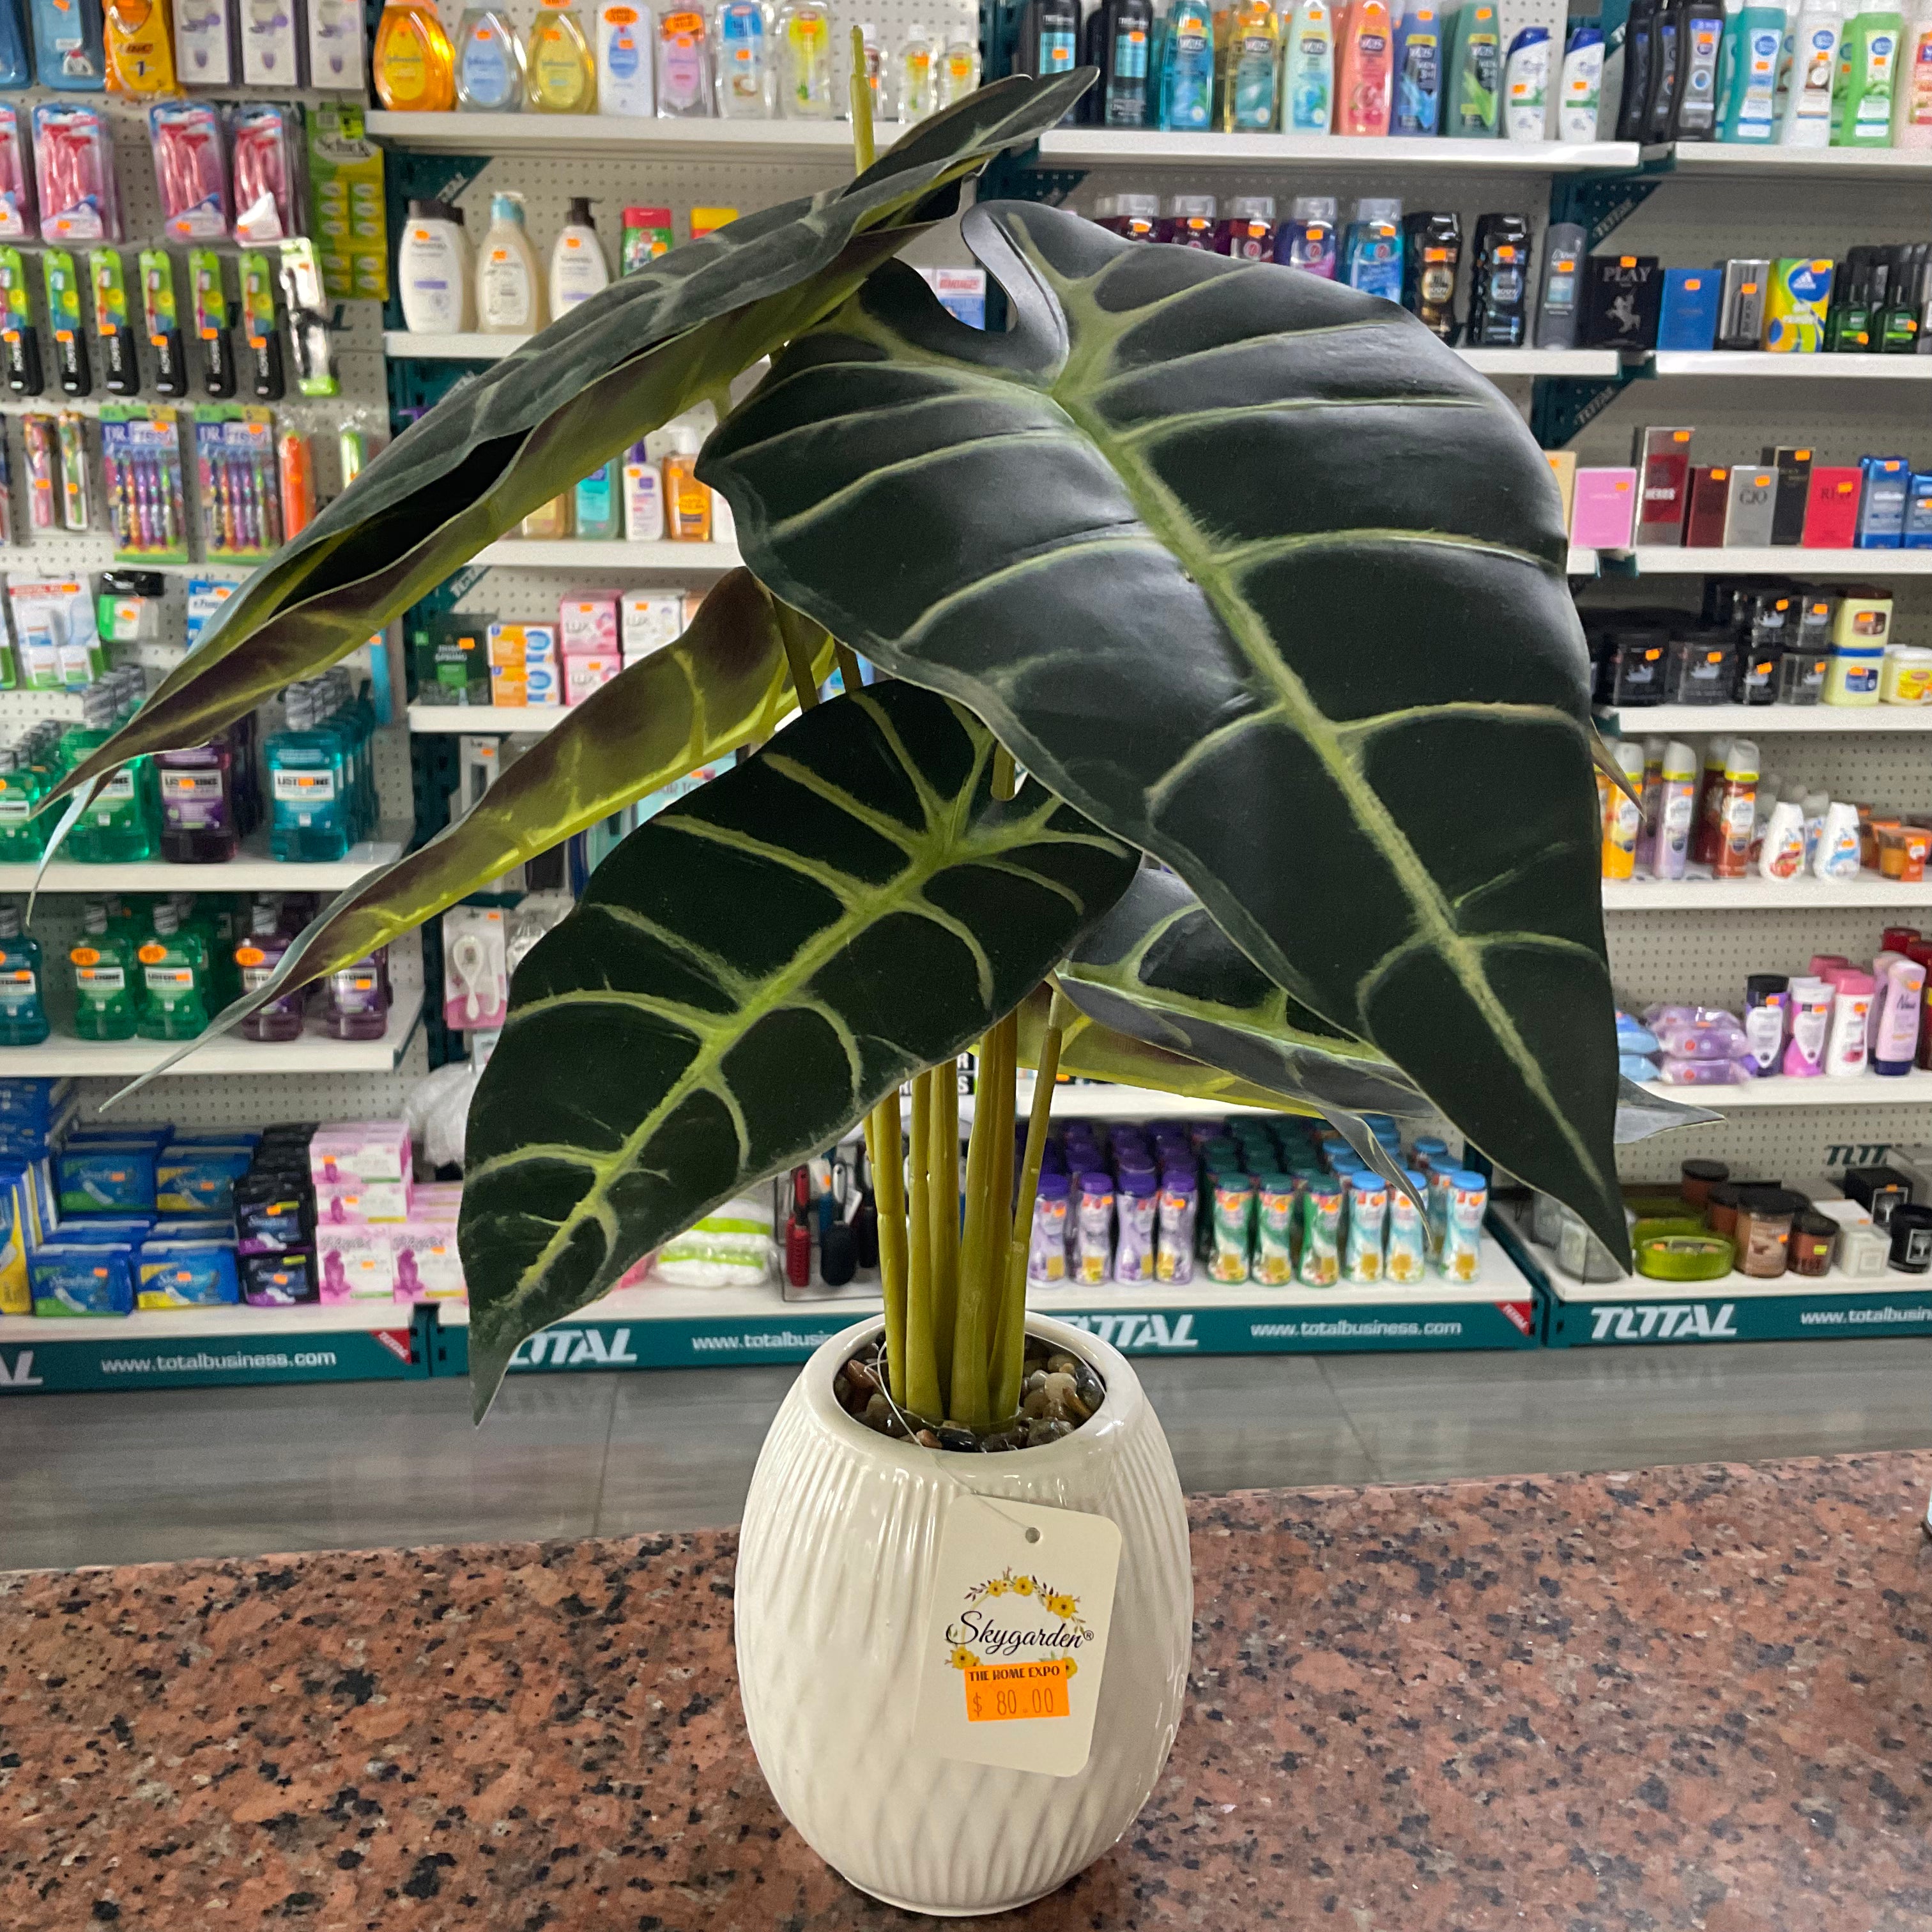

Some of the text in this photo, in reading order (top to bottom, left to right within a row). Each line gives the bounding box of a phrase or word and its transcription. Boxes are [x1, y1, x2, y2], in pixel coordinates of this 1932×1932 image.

[1603, 266, 1651, 282] PLAY
[1250, 1319, 1462, 1337] www.totalbusiness.com
[1591, 1304, 1737, 1339] TOTAL
[509, 1328, 638, 1365] OTAL
[101, 1351, 336, 1373] www.totalbusiness.com
[969, 1666, 1060, 1682] THE HOME EXPO
[972, 1692, 983, 1717] $
